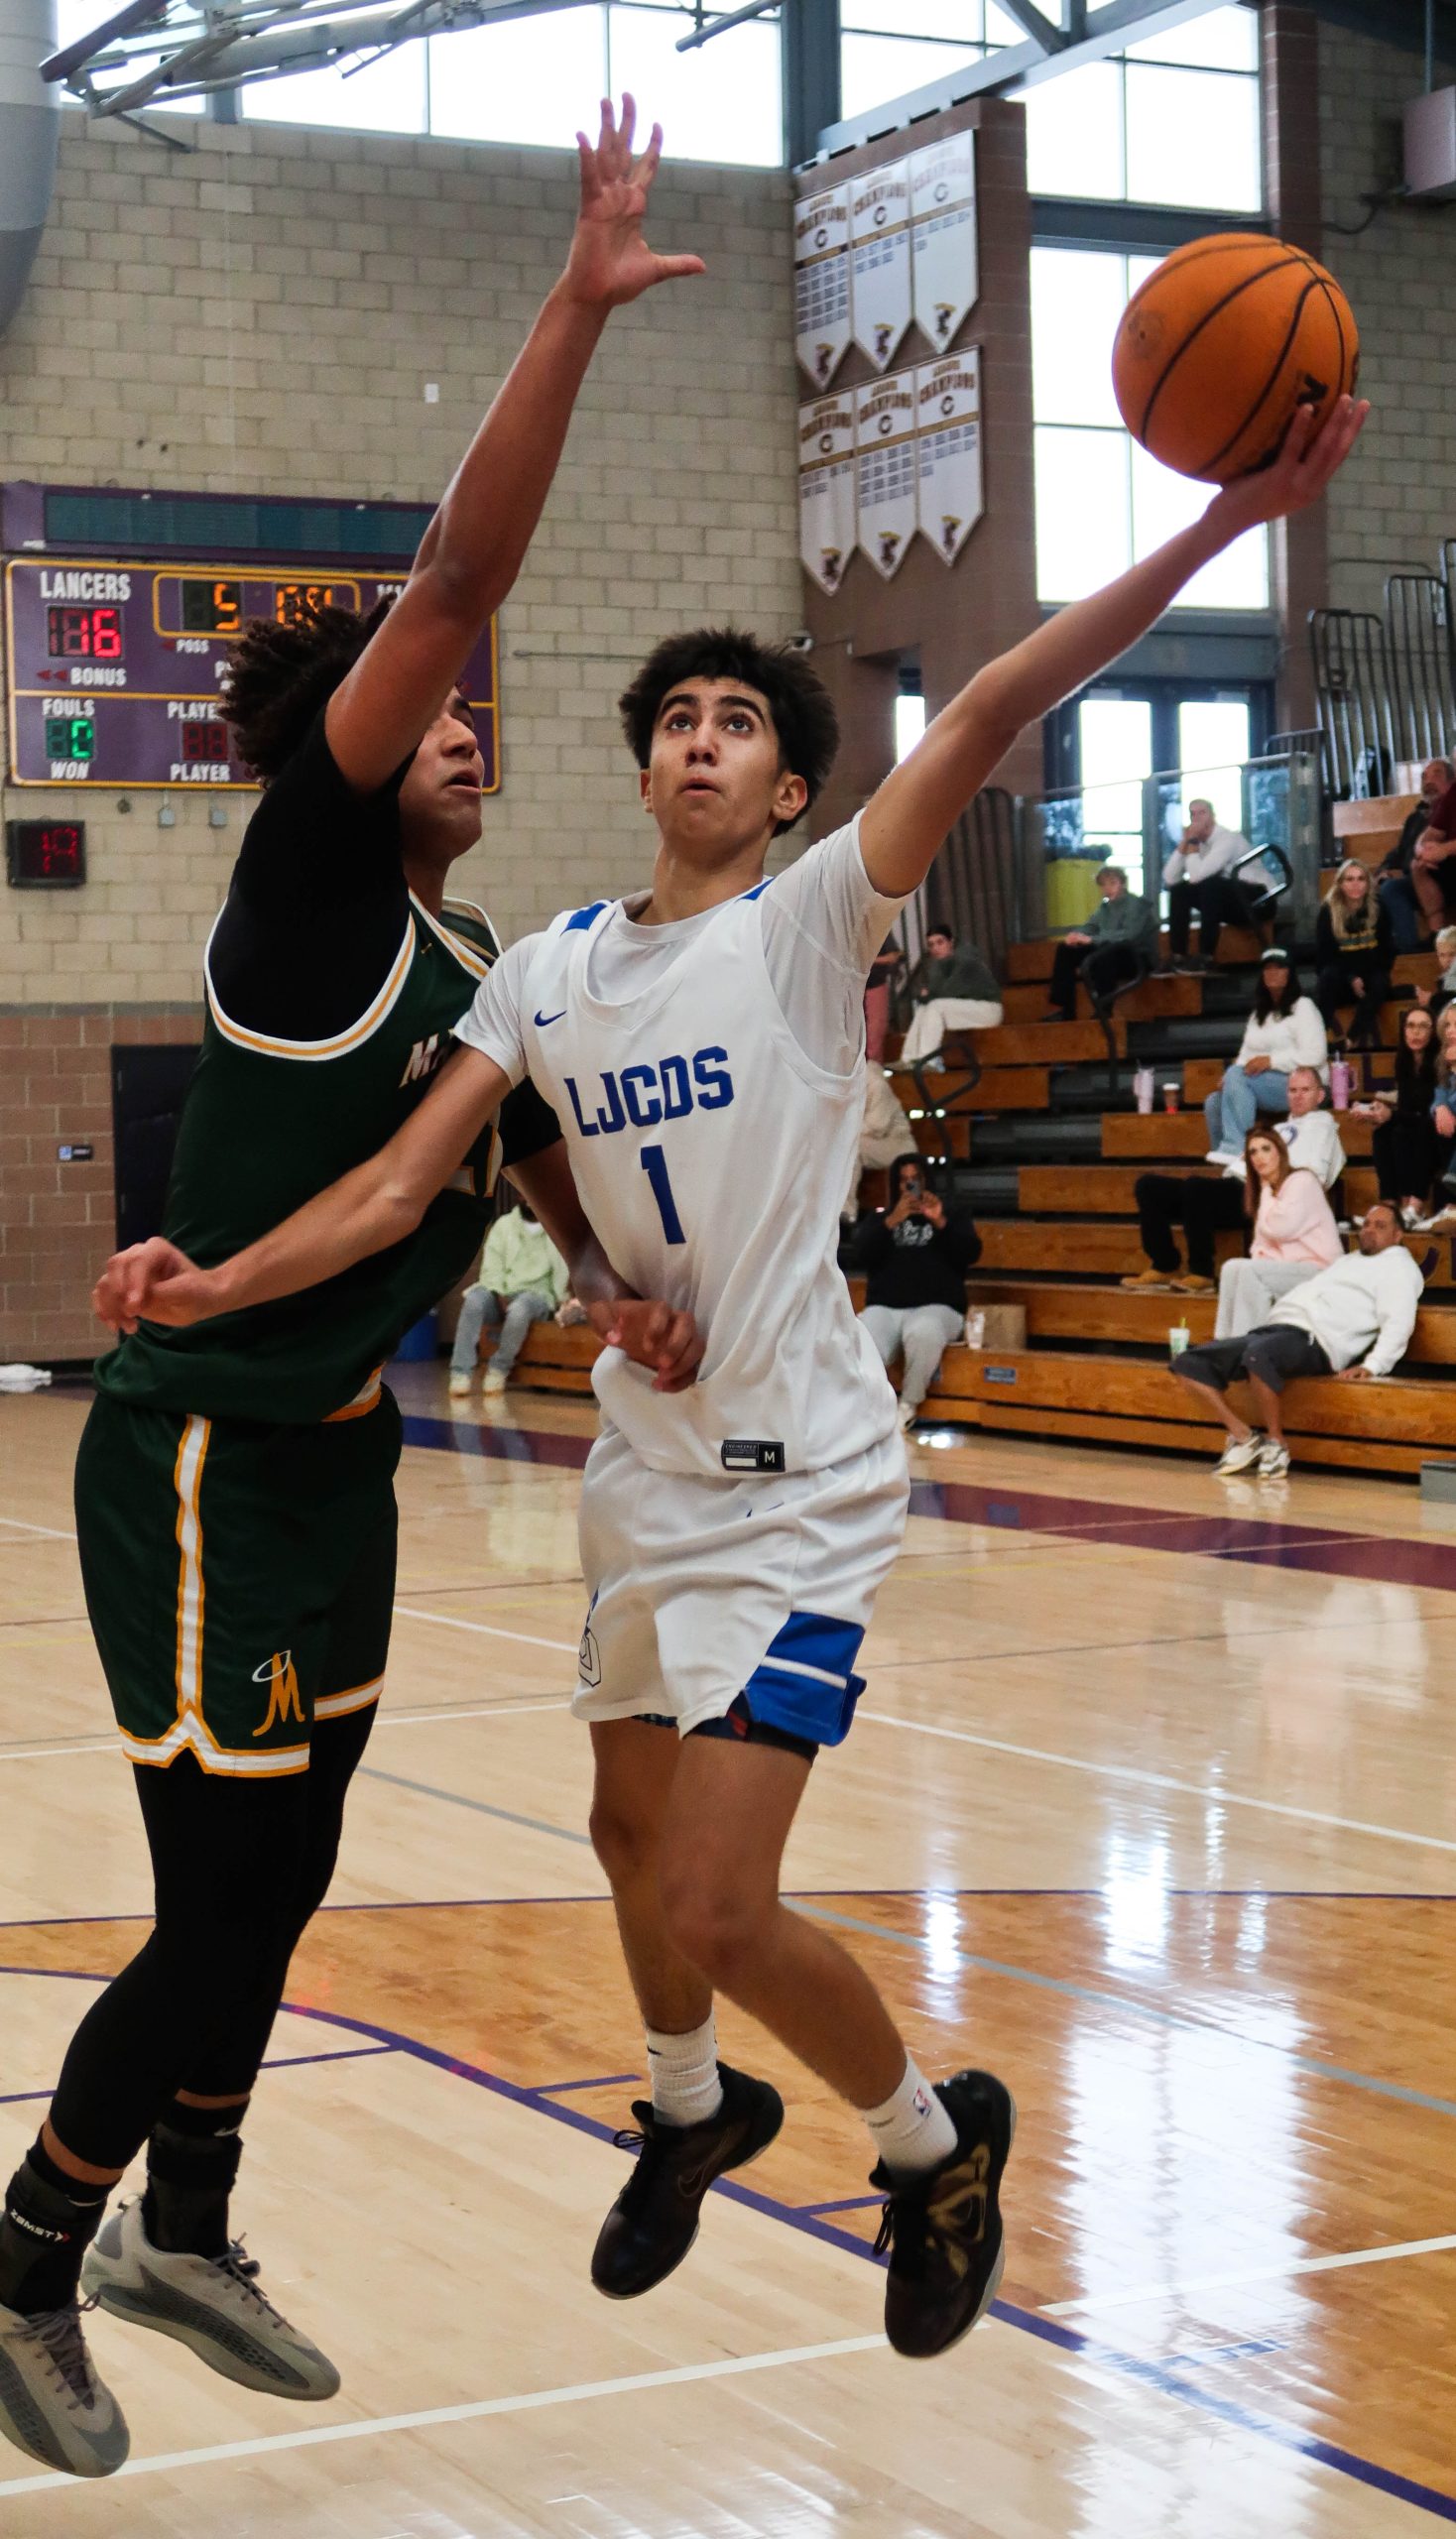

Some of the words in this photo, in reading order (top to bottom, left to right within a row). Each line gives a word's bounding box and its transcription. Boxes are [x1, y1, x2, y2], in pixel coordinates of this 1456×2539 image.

[40, 570, 132, 602] LANCERS
[213, 582, 241, 632] 5
[79, 608, 122, 659] 16
[69, 665, 127, 686] BONUS
[42, 697, 95, 717] FOULS
[167, 700, 222, 720] PLAYE
[51, 761, 89, 781] WON
[170, 763, 230, 782] PLAYER
[563, 1045, 735, 1137] LJCDS
[640, 1144, 687, 1246] 1
[765, 1451, 776, 1464] M
